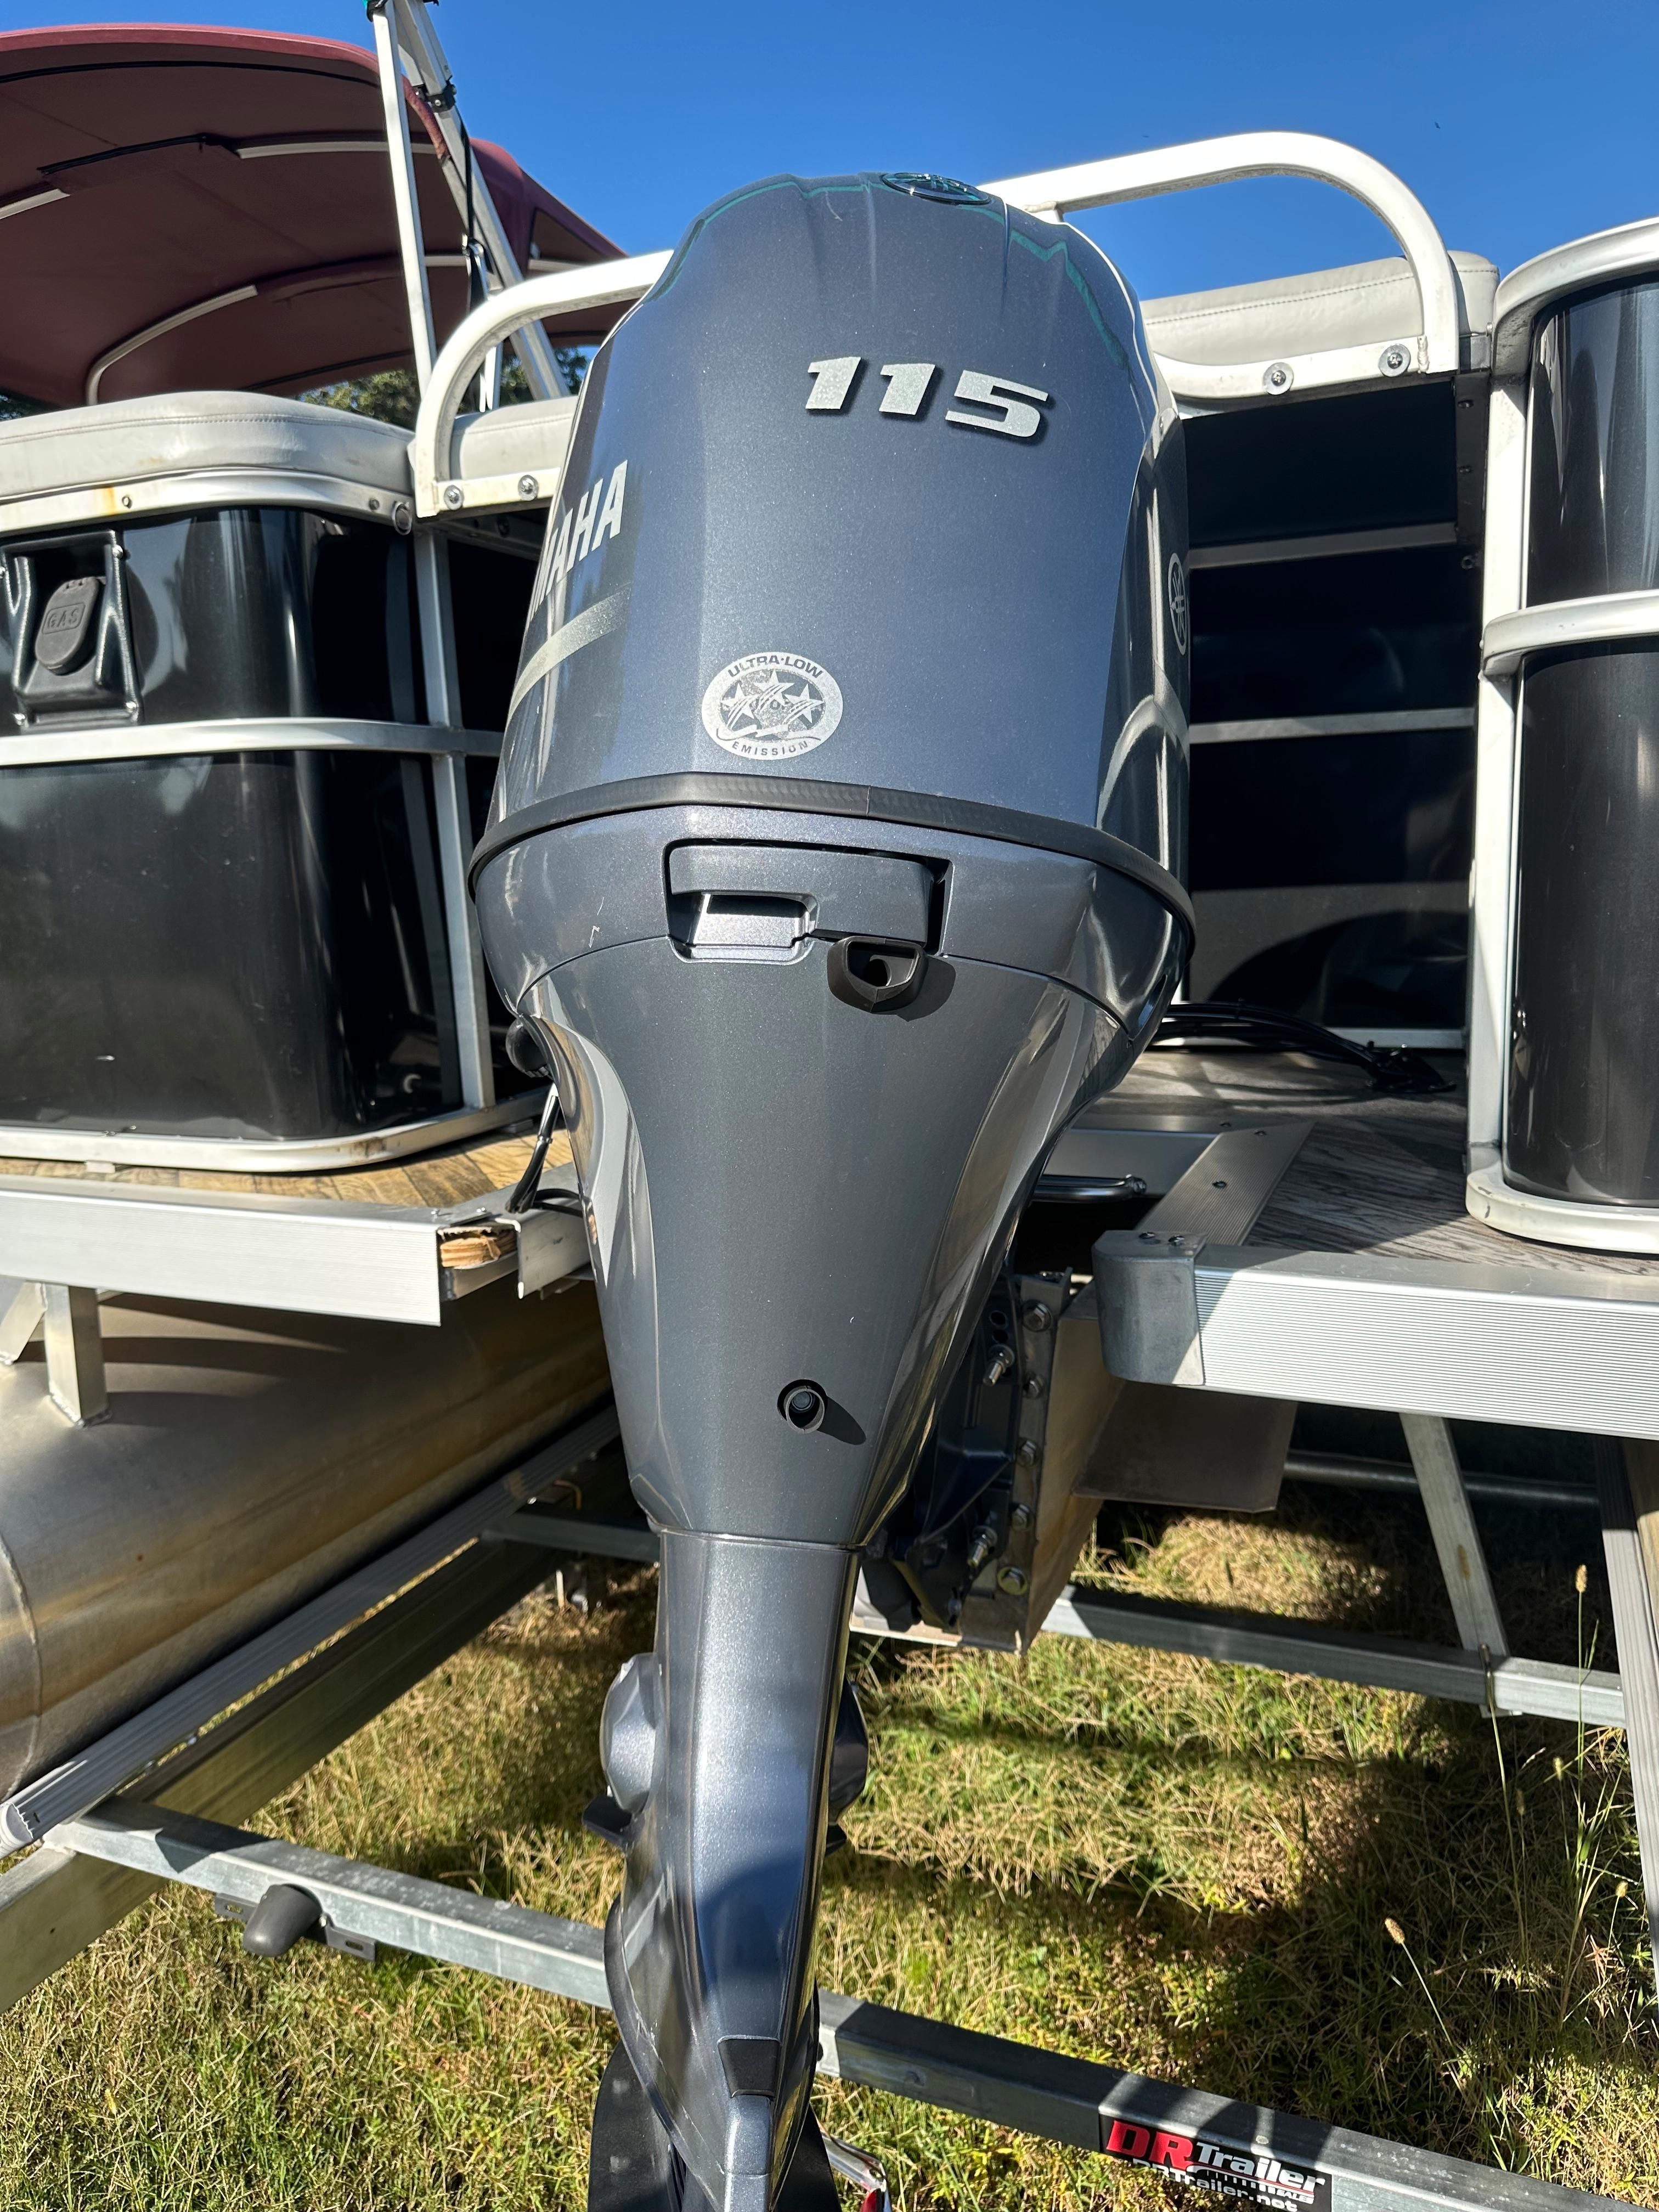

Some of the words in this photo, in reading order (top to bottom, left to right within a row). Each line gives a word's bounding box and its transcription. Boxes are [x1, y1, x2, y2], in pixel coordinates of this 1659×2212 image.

[805, 356, 1048, 437] 115
[47, 608, 80, 629] GAS
[731, 741, 808, 756] EMISSION
